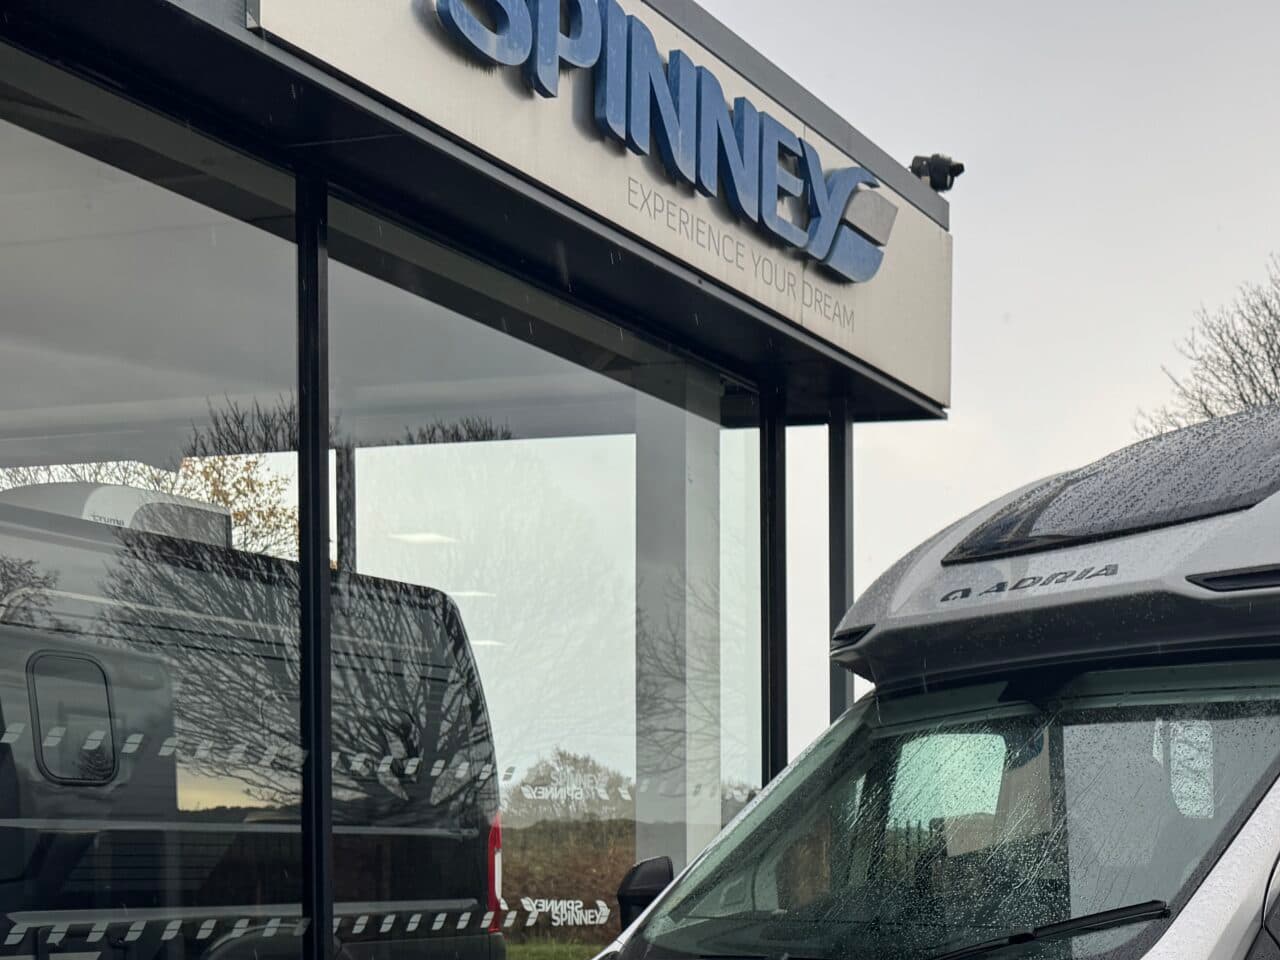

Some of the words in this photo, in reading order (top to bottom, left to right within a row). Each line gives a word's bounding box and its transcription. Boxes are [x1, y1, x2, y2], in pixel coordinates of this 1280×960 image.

[627, 176, 745, 271] EXPERIENCE
[751, 250, 796, 301] YOUR
[802, 279, 855, 334] DREAM
[979, 563, 1119, 597] ADRIA
[551, 908, 606, 926] SPINNEY
